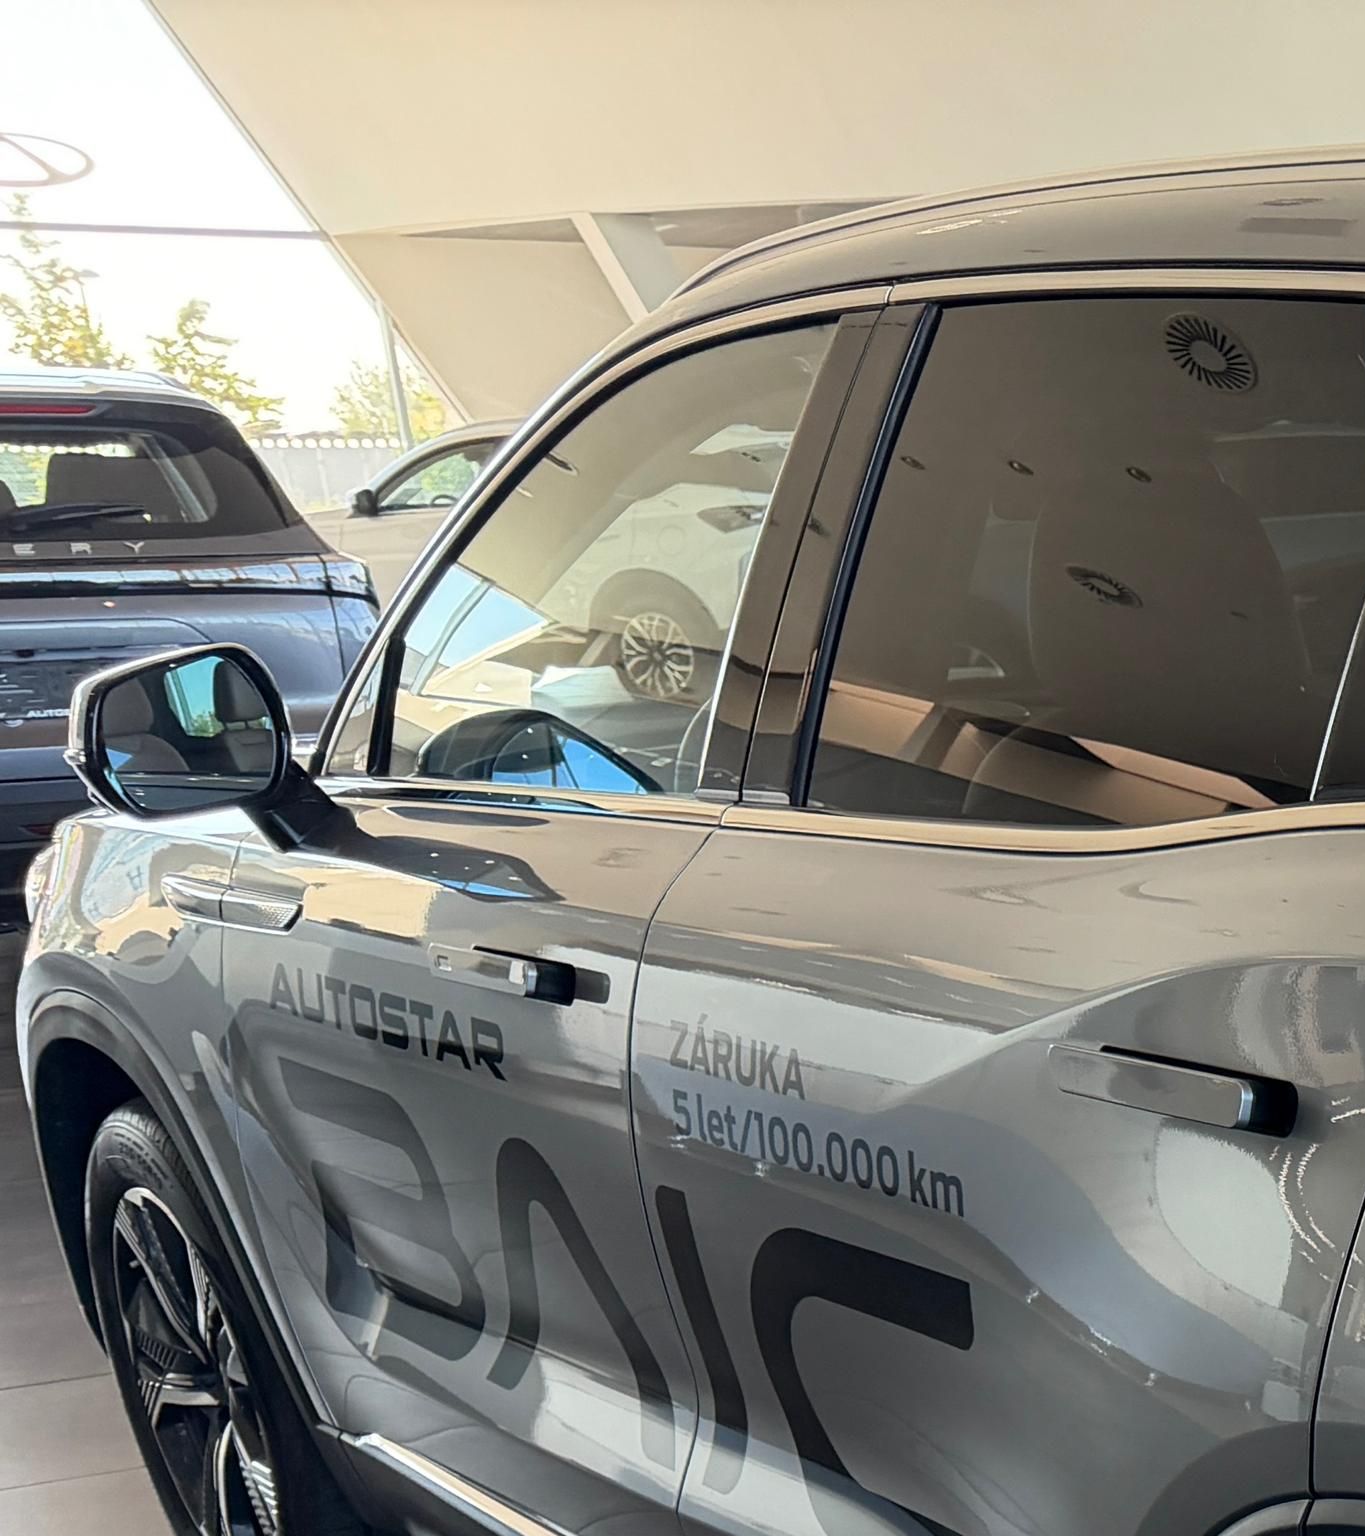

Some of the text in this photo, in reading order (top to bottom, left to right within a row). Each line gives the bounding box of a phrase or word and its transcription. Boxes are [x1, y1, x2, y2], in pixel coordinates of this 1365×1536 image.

[270, 962, 508, 1082] AUTOSTAR
[668, 1018, 806, 1101] ZÁRUKA
[908, 1150, 965, 1218] km
